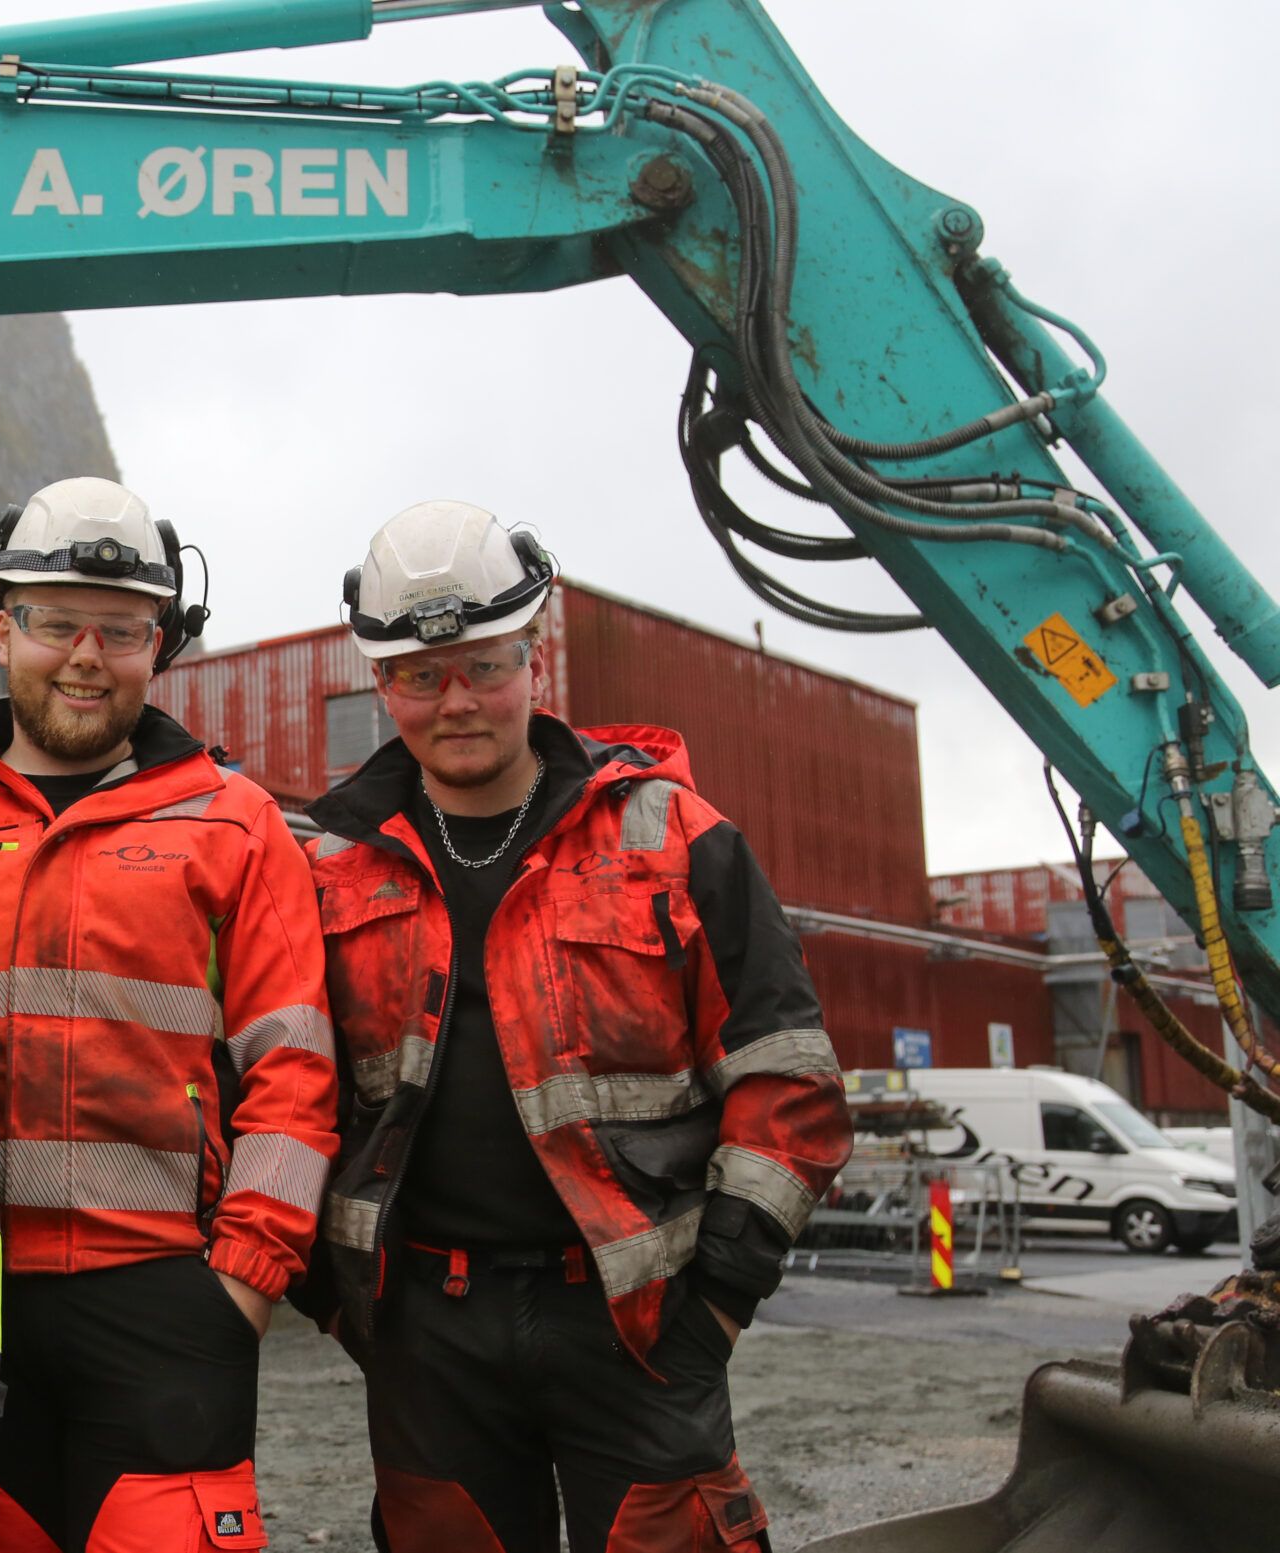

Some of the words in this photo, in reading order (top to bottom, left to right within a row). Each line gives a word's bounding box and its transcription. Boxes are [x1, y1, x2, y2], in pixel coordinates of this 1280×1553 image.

[11, 148, 104, 216] A.
[137, 145, 409, 219] ØREN
[399, 591, 425, 602] DANIEL
[118, 864, 166, 873] HØYANGER
[217, 1524, 242, 1534] BULLDOG
